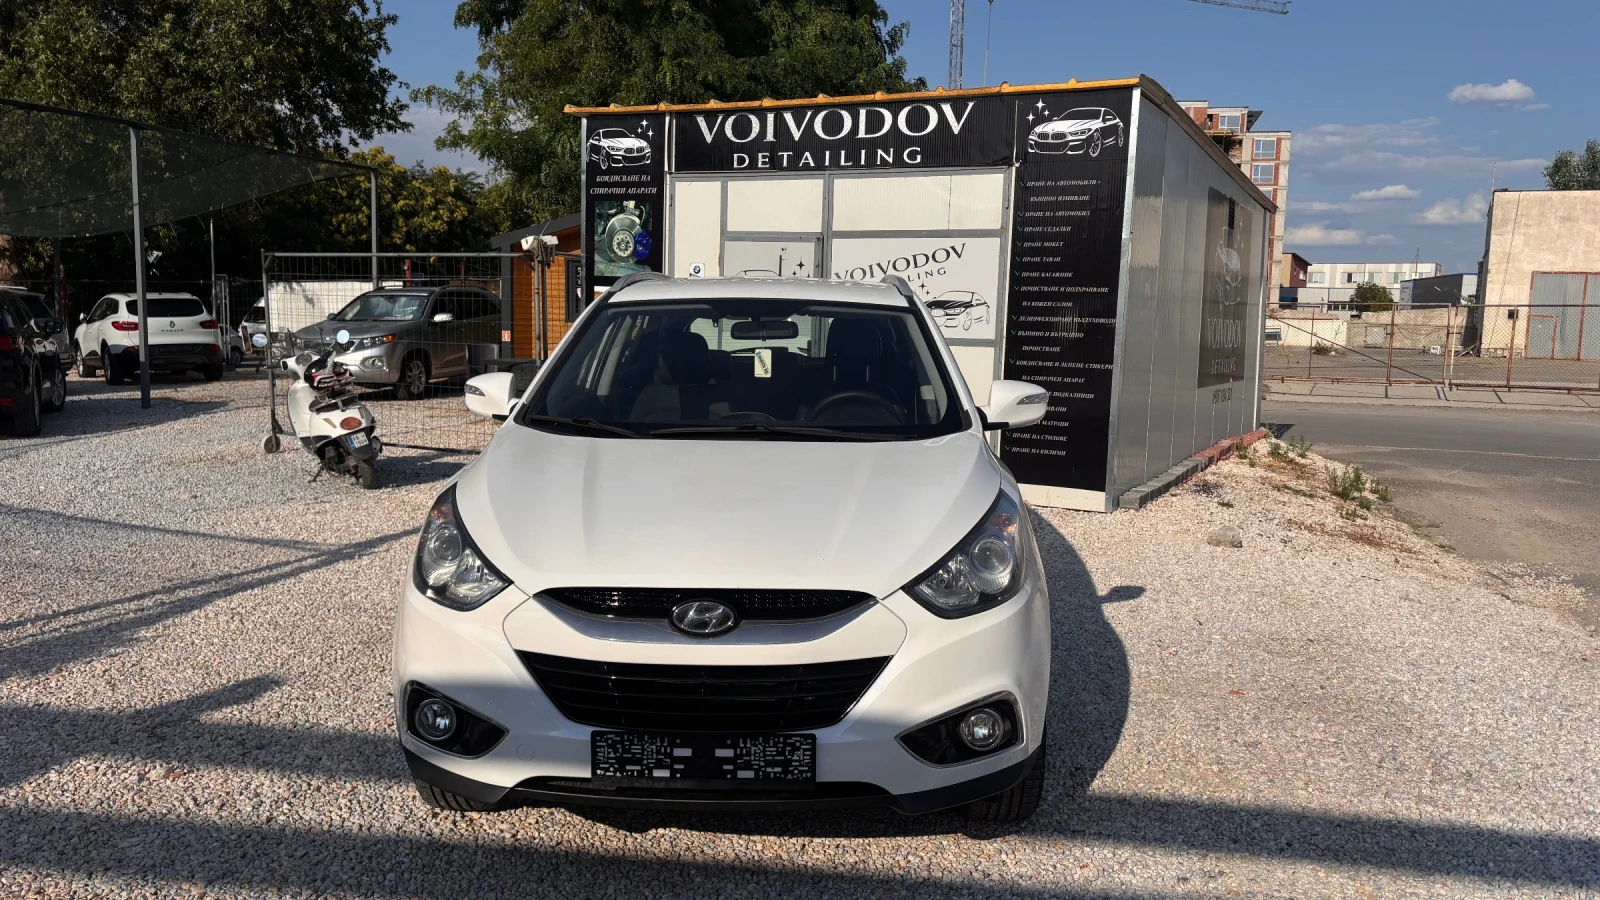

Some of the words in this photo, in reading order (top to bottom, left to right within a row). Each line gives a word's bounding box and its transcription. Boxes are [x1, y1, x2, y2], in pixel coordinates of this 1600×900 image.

[694, 101, 977, 144] VOIVODOV
[733, 147, 922, 168] DETAILING
[596, 174, 640, 182] БОЯДИСВАНЕ
[833, 242, 966, 281] VOIVODOV
[1208, 318, 1244, 349] VOIVODOV
